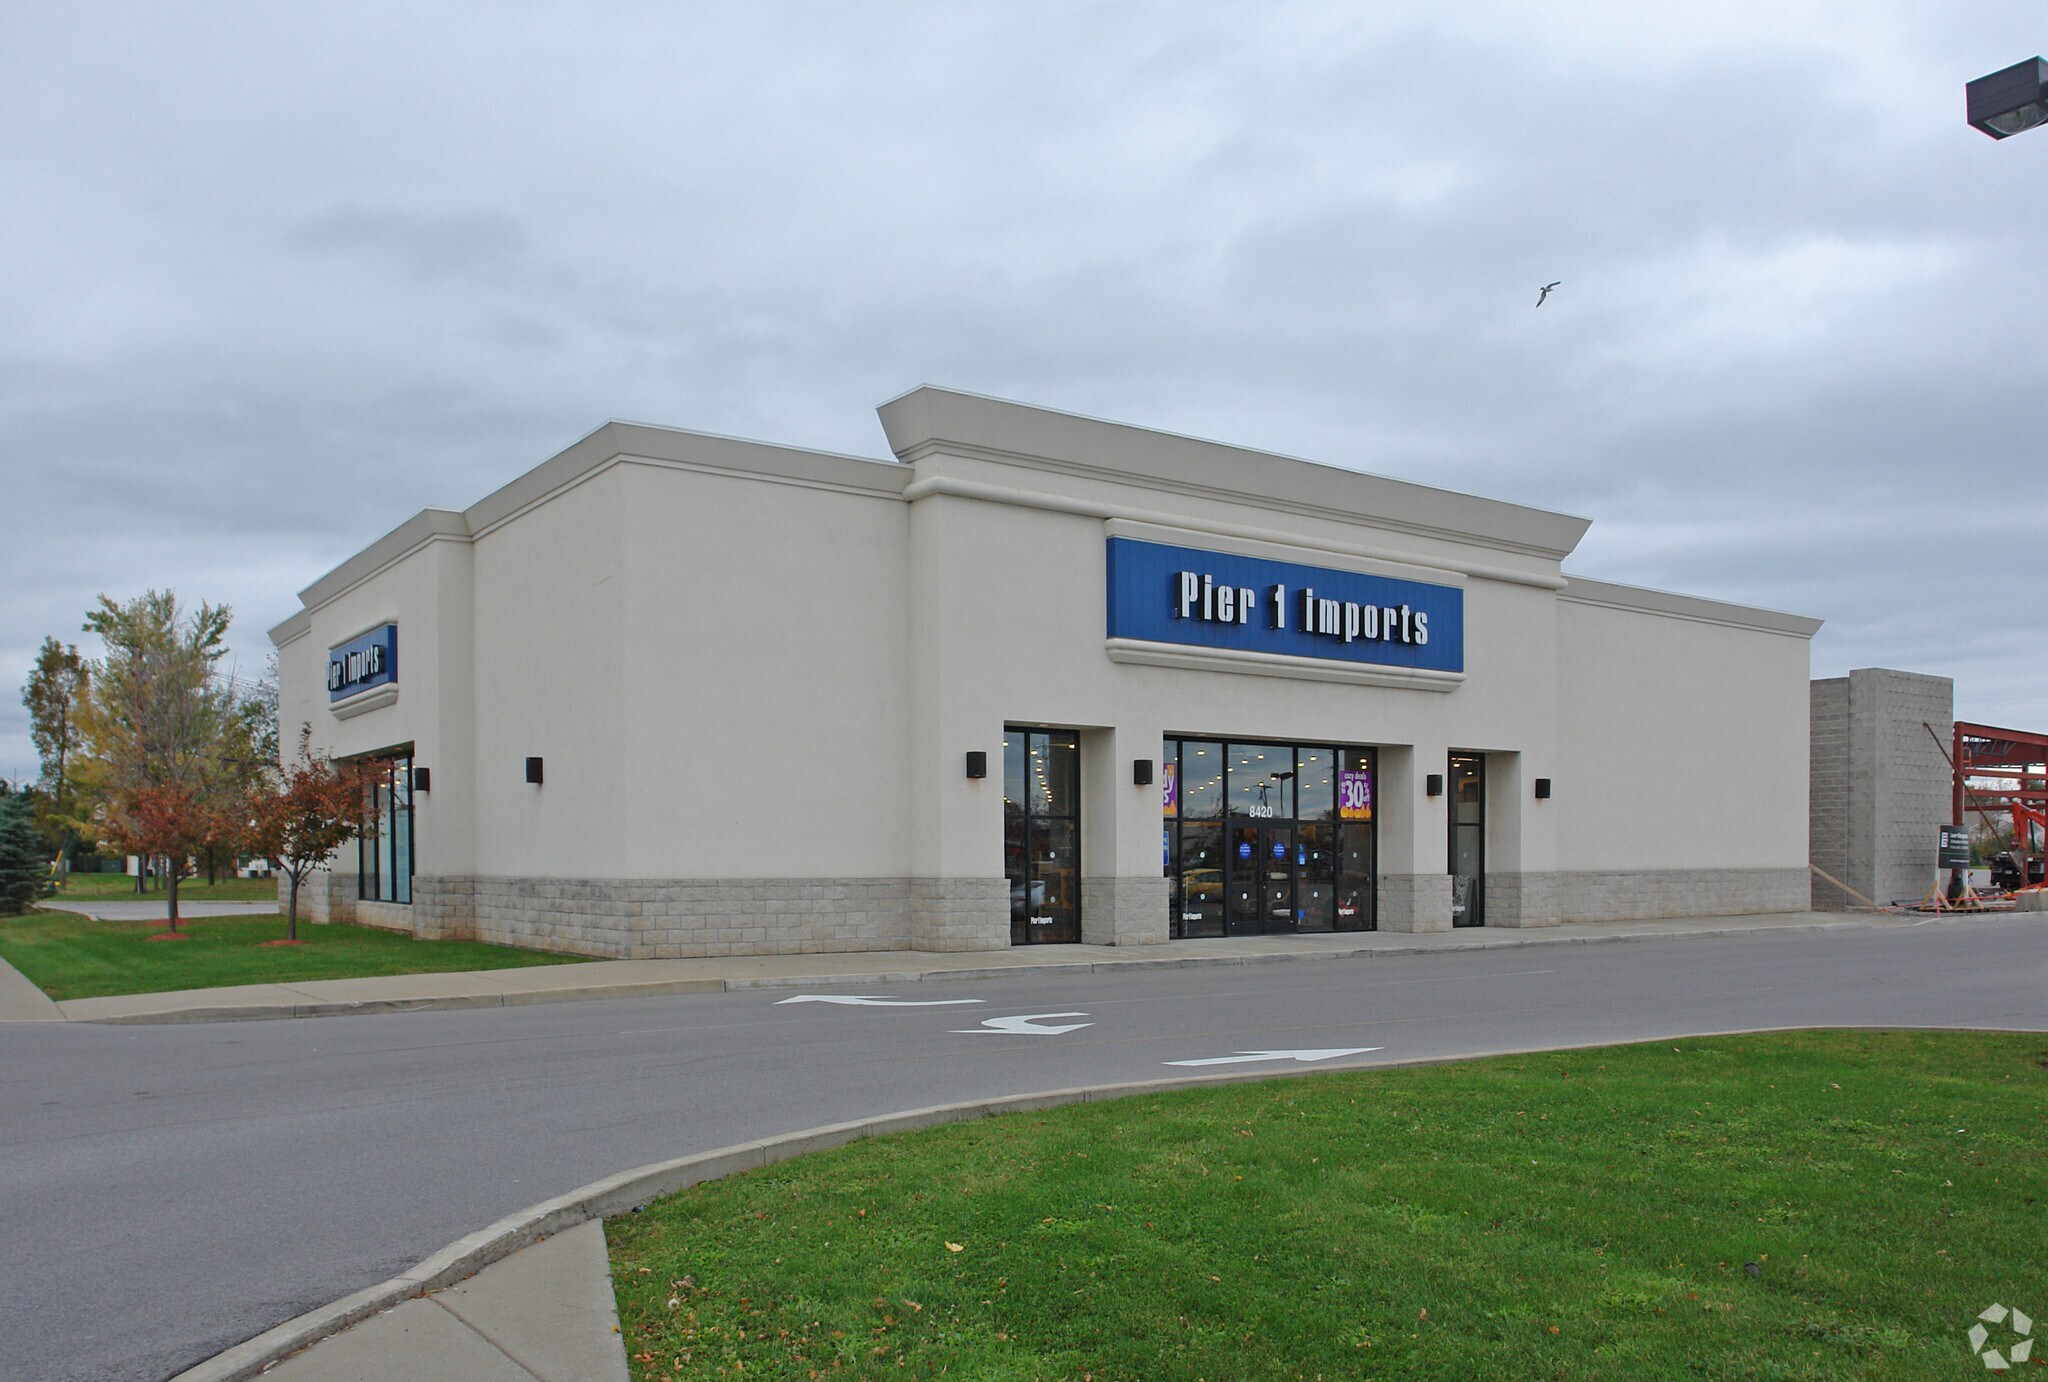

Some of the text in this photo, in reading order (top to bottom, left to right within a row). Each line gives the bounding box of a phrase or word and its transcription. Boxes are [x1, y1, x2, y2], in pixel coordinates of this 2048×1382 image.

[1176, 571, 1430, 646] Pier 1 imports
[1249, 805, 1273, 818] 8420
